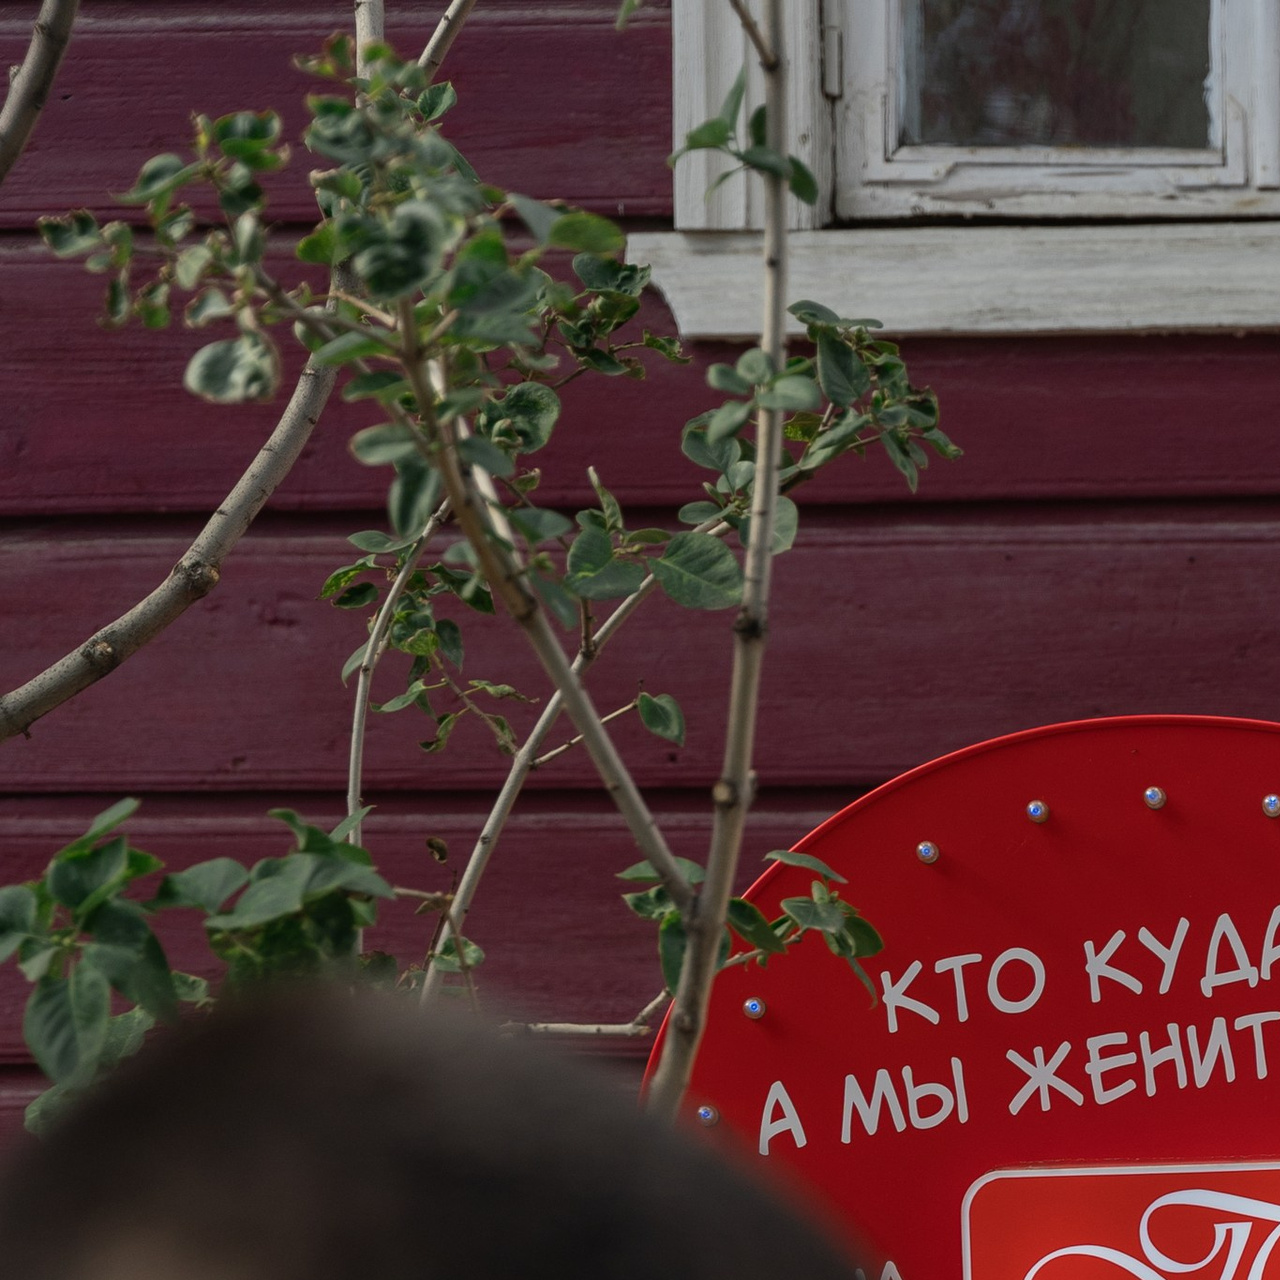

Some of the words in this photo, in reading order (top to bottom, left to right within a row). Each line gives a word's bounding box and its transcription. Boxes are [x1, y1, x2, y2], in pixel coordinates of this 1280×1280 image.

[880, 947, 1047, 1034] КТО
[758, 1080, 808, 1156] А
[840, 1056, 969, 1144] МЫ
